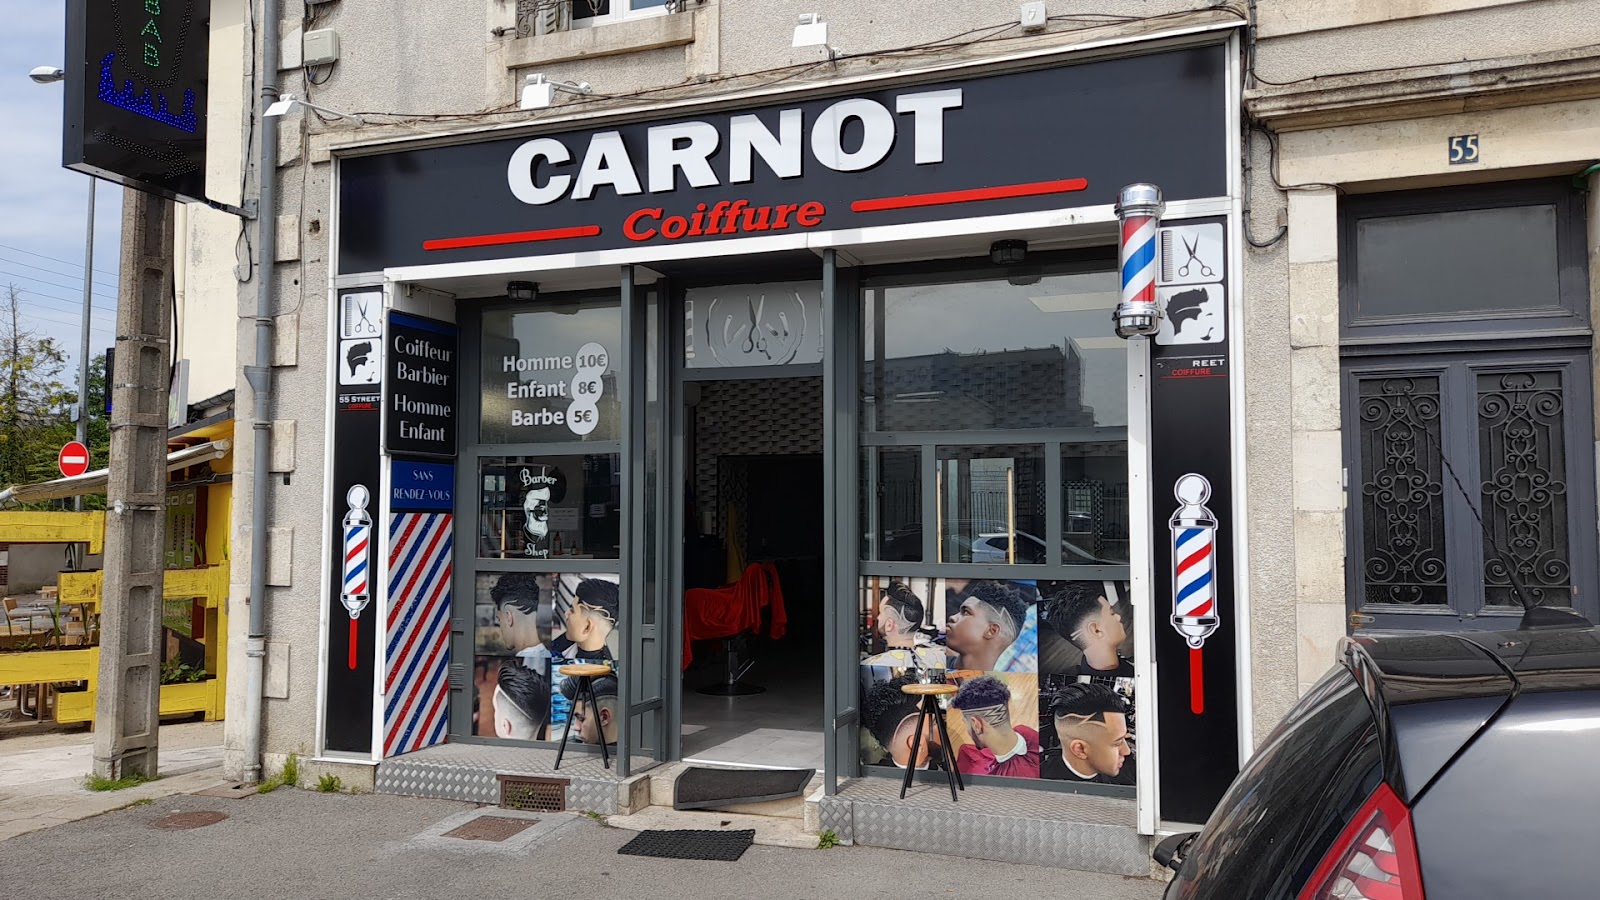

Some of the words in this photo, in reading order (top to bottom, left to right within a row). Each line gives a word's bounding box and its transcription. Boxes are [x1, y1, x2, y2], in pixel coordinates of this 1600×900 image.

[507, 88, 963, 206] CARNOT
[1450, 136, 1478, 162] 55
[622, 199, 826, 241] Coiffure
[394, 335, 452, 362] Coiffeur
[503, 355, 573, 372] Homme
[579, 353, 607, 368] 10€
[1171, 367, 1212, 376] COIFFURE
[1192, 359, 1226, 367] REET
[397, 361, 450, 386] Barbier
[507, 380, 567, 399] Enfant
[578, 381, 597, 394] 8€
[394, 393, 451, 418] Homme
[511, 407, 565, 426] Barbe
[573, 409, 593, 424] 5€
[400, 420, 446, 442] Enfant
[412, 469, 434, 481] SANS
[519, 465, 558, 487] Barber
[393, 487, 450, 500] RENDEZ-VOUS
[524, 542, 549, 559] Shop
